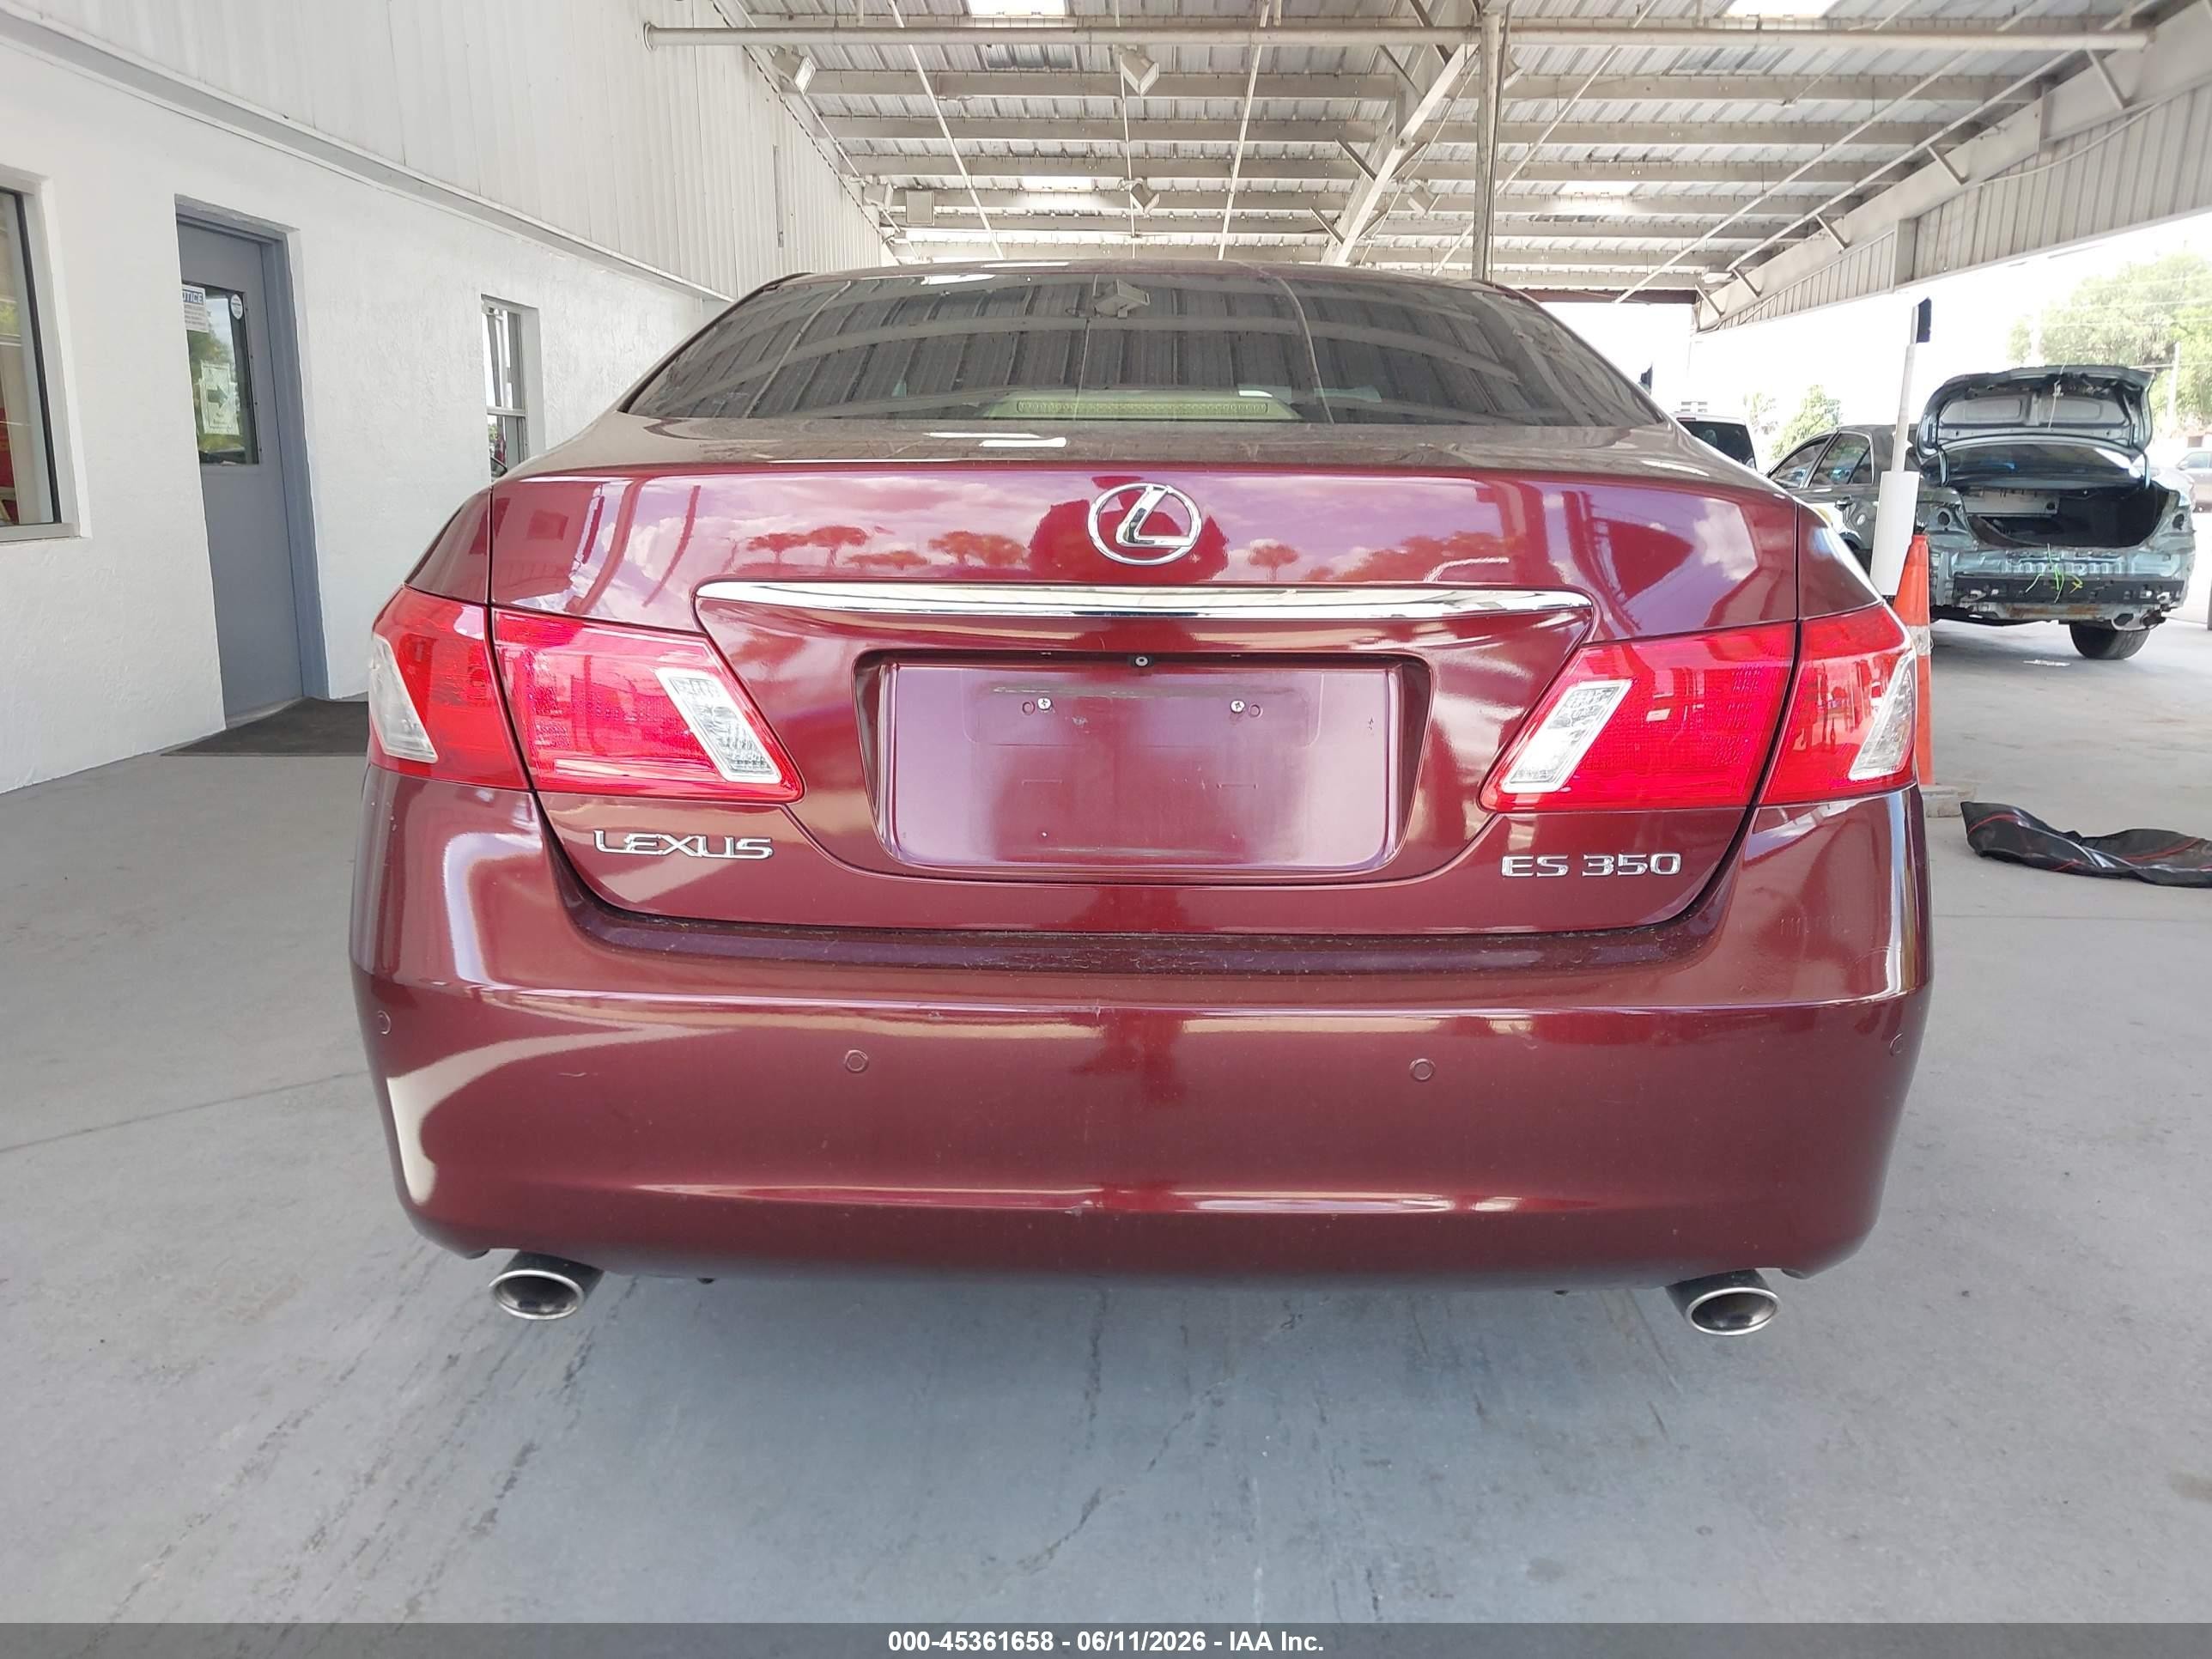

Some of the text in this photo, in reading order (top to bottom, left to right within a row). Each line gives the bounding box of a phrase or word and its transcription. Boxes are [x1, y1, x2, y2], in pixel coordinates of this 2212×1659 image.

[593, 830, 773, 860] LEXUS
[1502, 854, 1682, 878] ES 350
